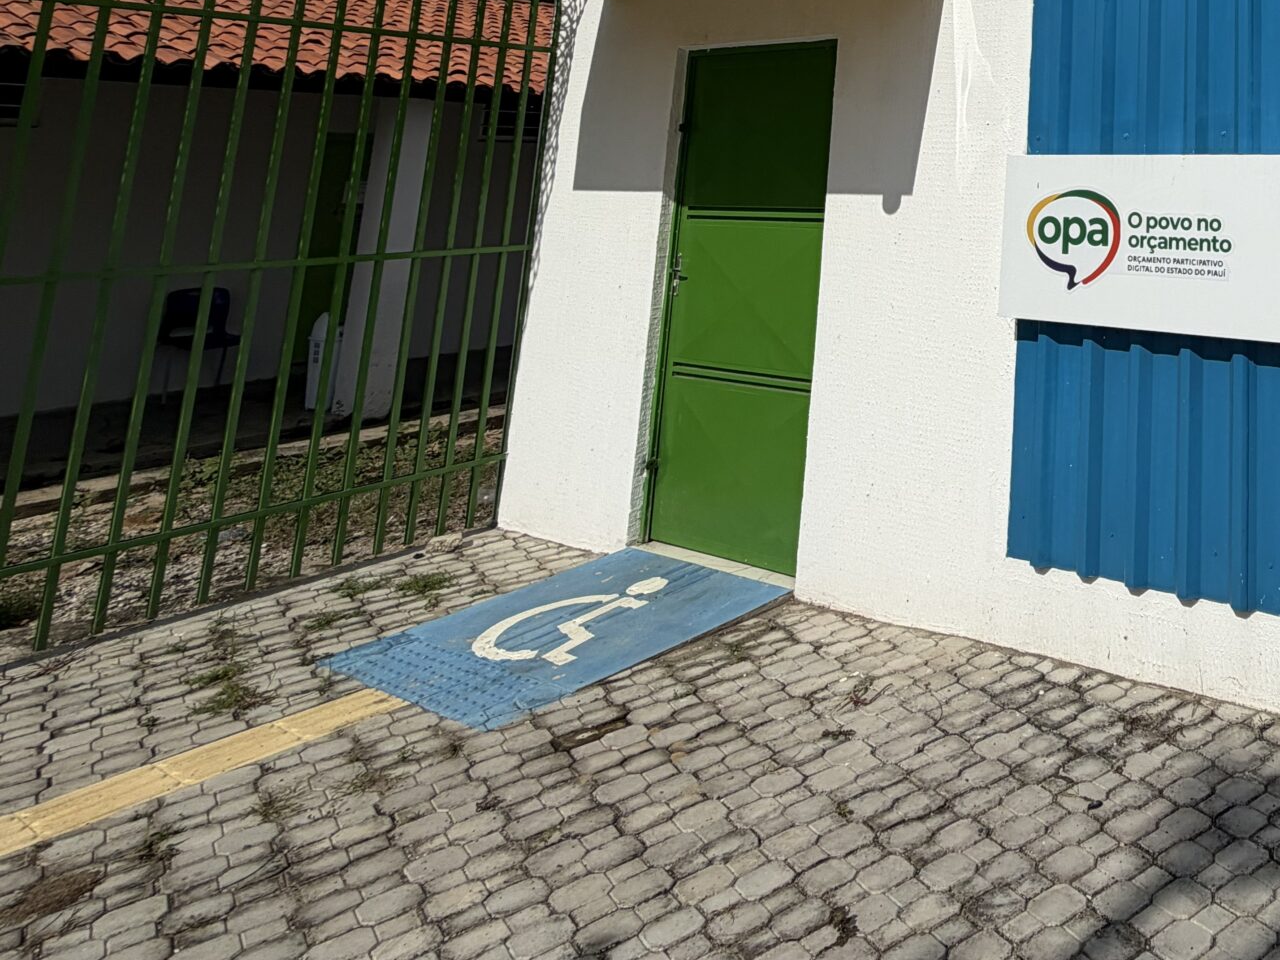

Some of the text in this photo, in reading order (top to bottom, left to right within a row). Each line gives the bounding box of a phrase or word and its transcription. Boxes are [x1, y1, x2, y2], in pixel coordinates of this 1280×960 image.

[1127, 211, 1222, 233] O povo no
[1038, 215, 1109, 255] opa
[1128, 235, 1232, 254] orçamento
[1127, 255, 1224, 268] ORÇAMENTO PARTICIPATIVO
[1127, 264, 1226, 278] DIGITAL DO ESTADO DO PIAUÍ
